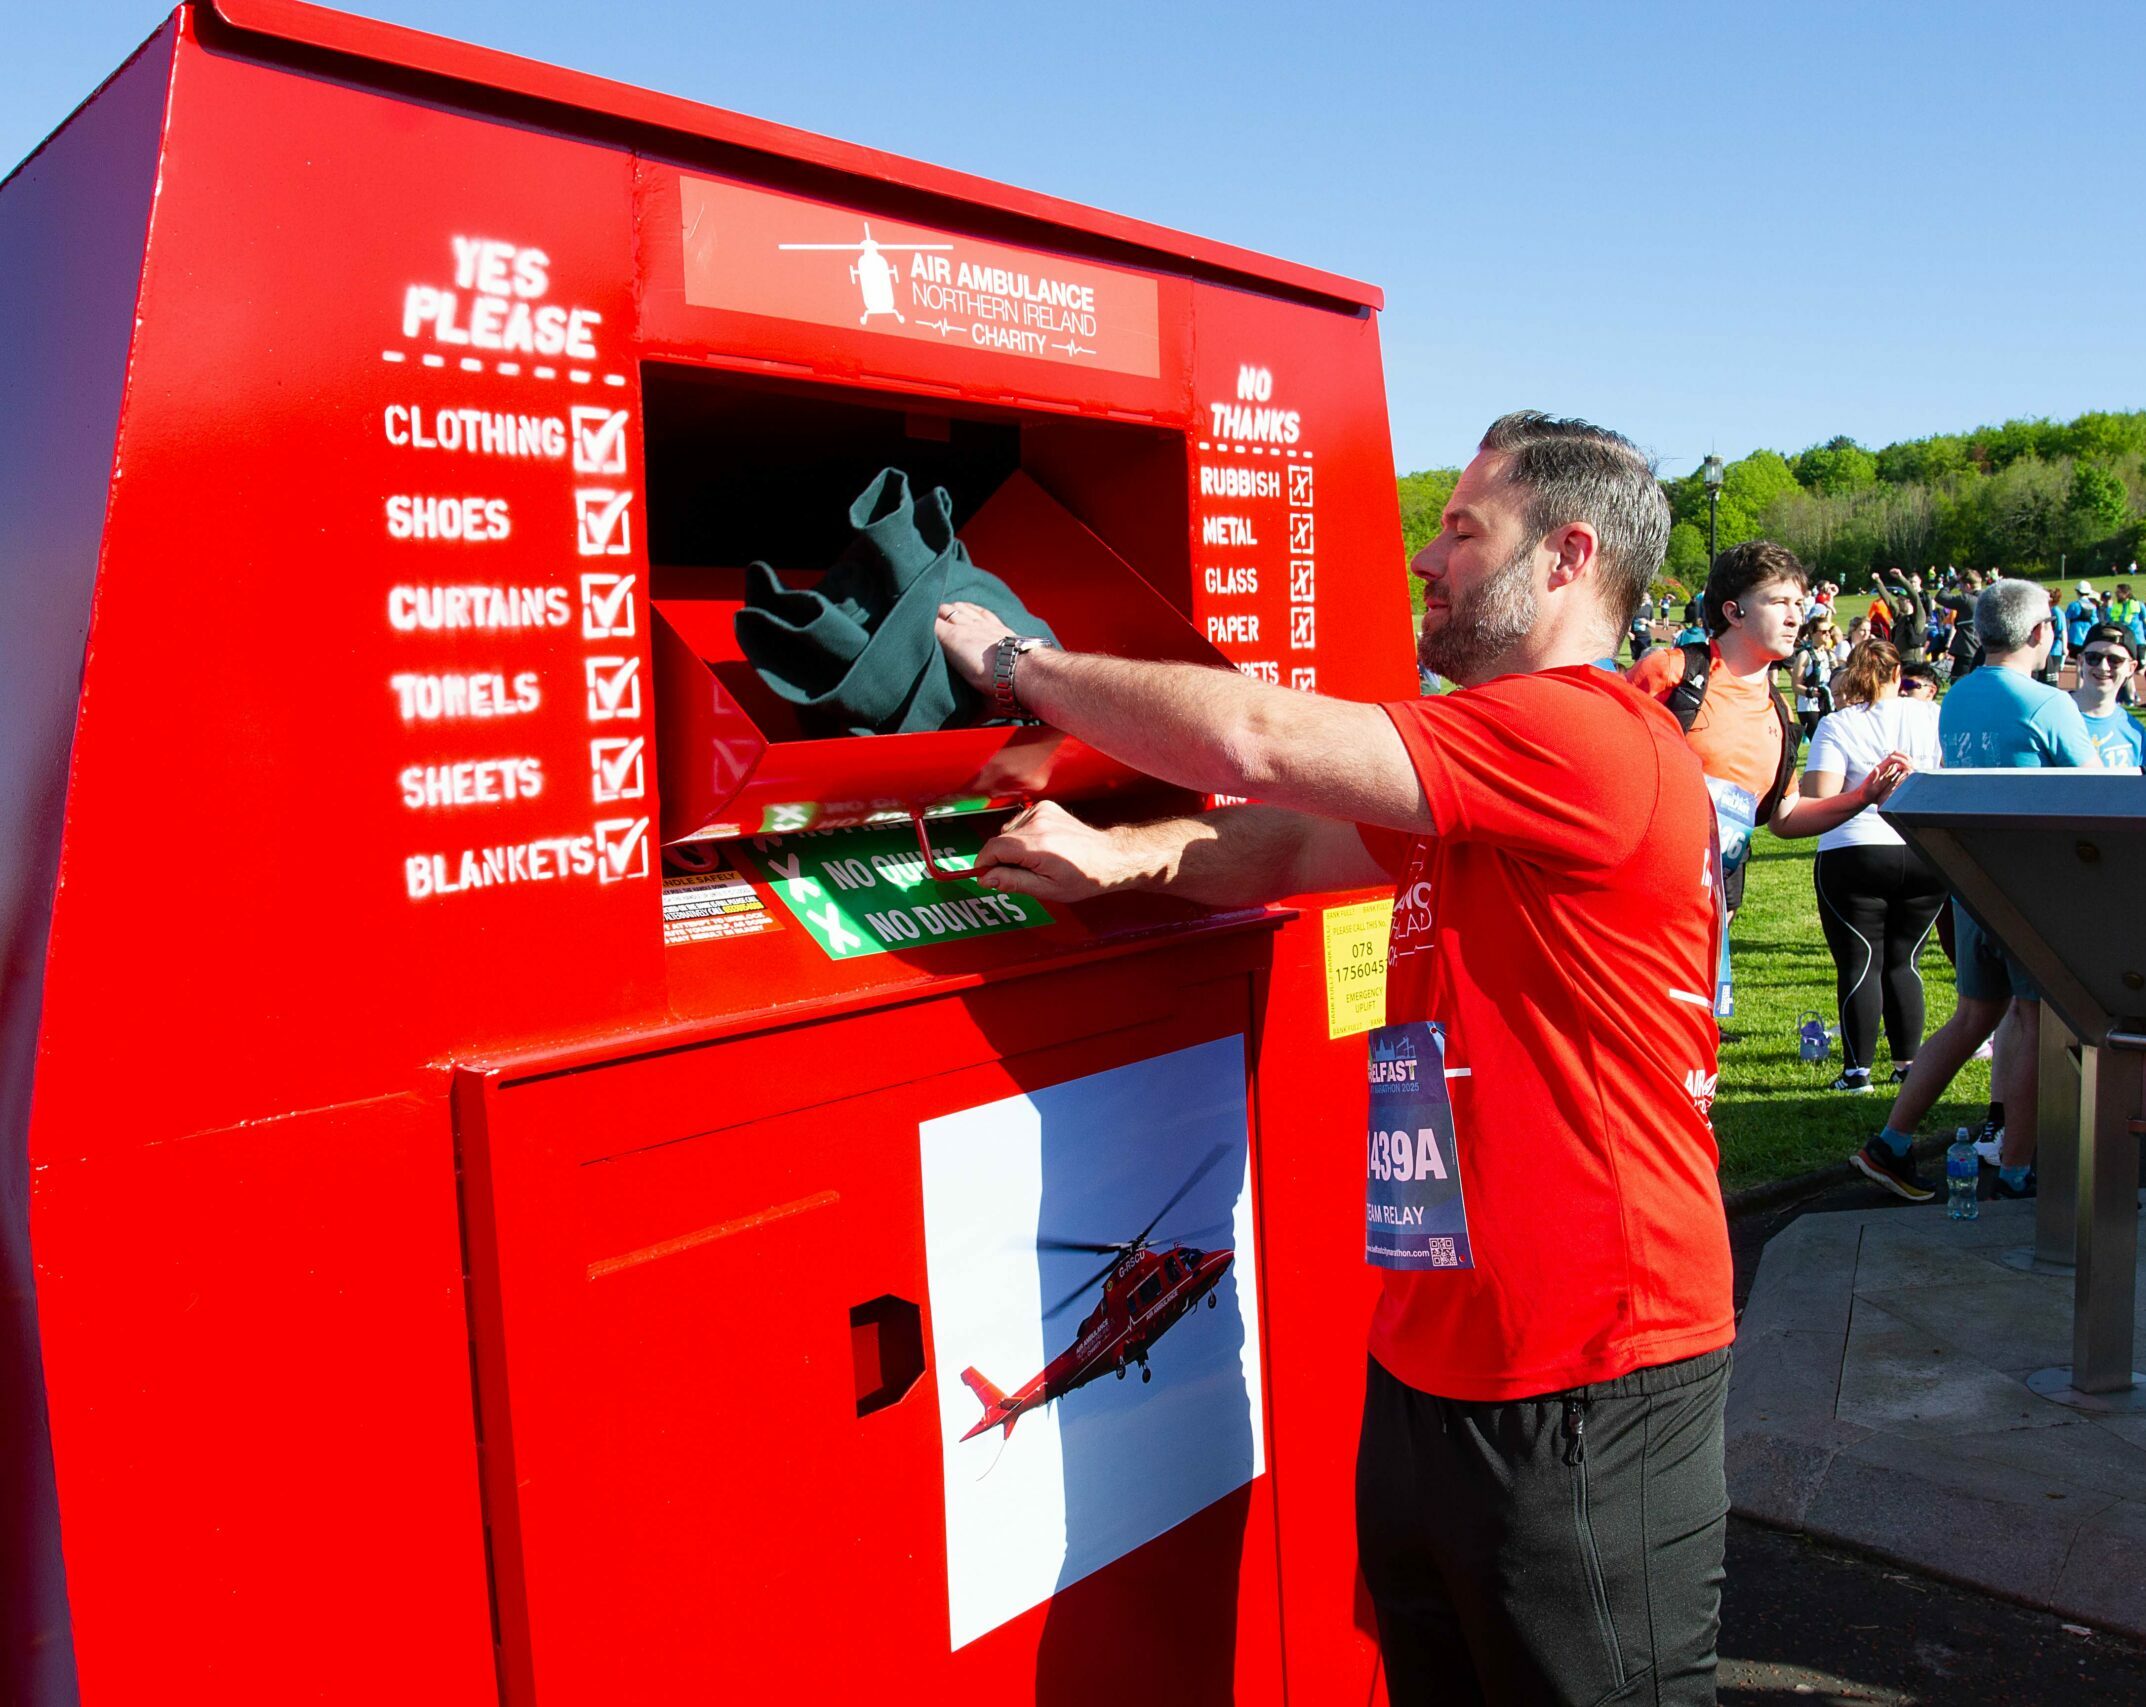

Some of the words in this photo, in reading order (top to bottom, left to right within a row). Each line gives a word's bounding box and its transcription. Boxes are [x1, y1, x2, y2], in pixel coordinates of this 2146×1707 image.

[451, 234, 550, 298] YES
[911, 252, 951, 284] AIR
[957, 262, 1094, 312] AMBULANCE
[402, 284, 602, 359] PLEASE
[912, 281, 1018, 323] NORTHERN
[1023, 303, 1096, 336] IRELAND
[972, 323, 1046, 354] CHARITY
[1237, 365, 1272, 401] NO
[385, 404, 567, 457] CLOTHING
[1210, 403, 1300, 444] THANKS
[1201, 466, 1280, 497] RUBBISH
[386, 495, 511, 540] SHOES
[1203, 516, 1257, 545] METAL
[1205, 567, 1258, 594] GLASS
[387, 584, 571, 630] CURTAINS
[1207, 616, 1259, 642] PAPER
[390, 671, 541, 720] TOWELS
[400, 757, 542, 809] SHEETS
[405, 834, 596, 899] BLANKETS
[700, 873, 735, 884] SAFELY
[821, 858, 876, 890] NO
[864, 910, 920, 942] NO
[911, 893, 1027, 935] DUVETS
[1333, 926, 1352, 936] PLEASE
[1353, 923, 1366, 933] CALL
[1366, 921, 1378, 931] THIS
[1352, 942, 1373, 958] 078
[1336, 959, 1388, 983] 1756045
[1346, 987, 1384, 1004] EMERGENCY
[1355, 1000, 1376, 1013] UPLIFT
[1402, 1082, 1420, 1092] 2025
[1383, 1205, 1424, 1225] RELAY
[1119, 1251, 1145, 1277] G-RSCU
[1153, 1290, 1179, 1315] AMBULANCE
[1083, 1318, 1109, 1346] AMBULANCE
